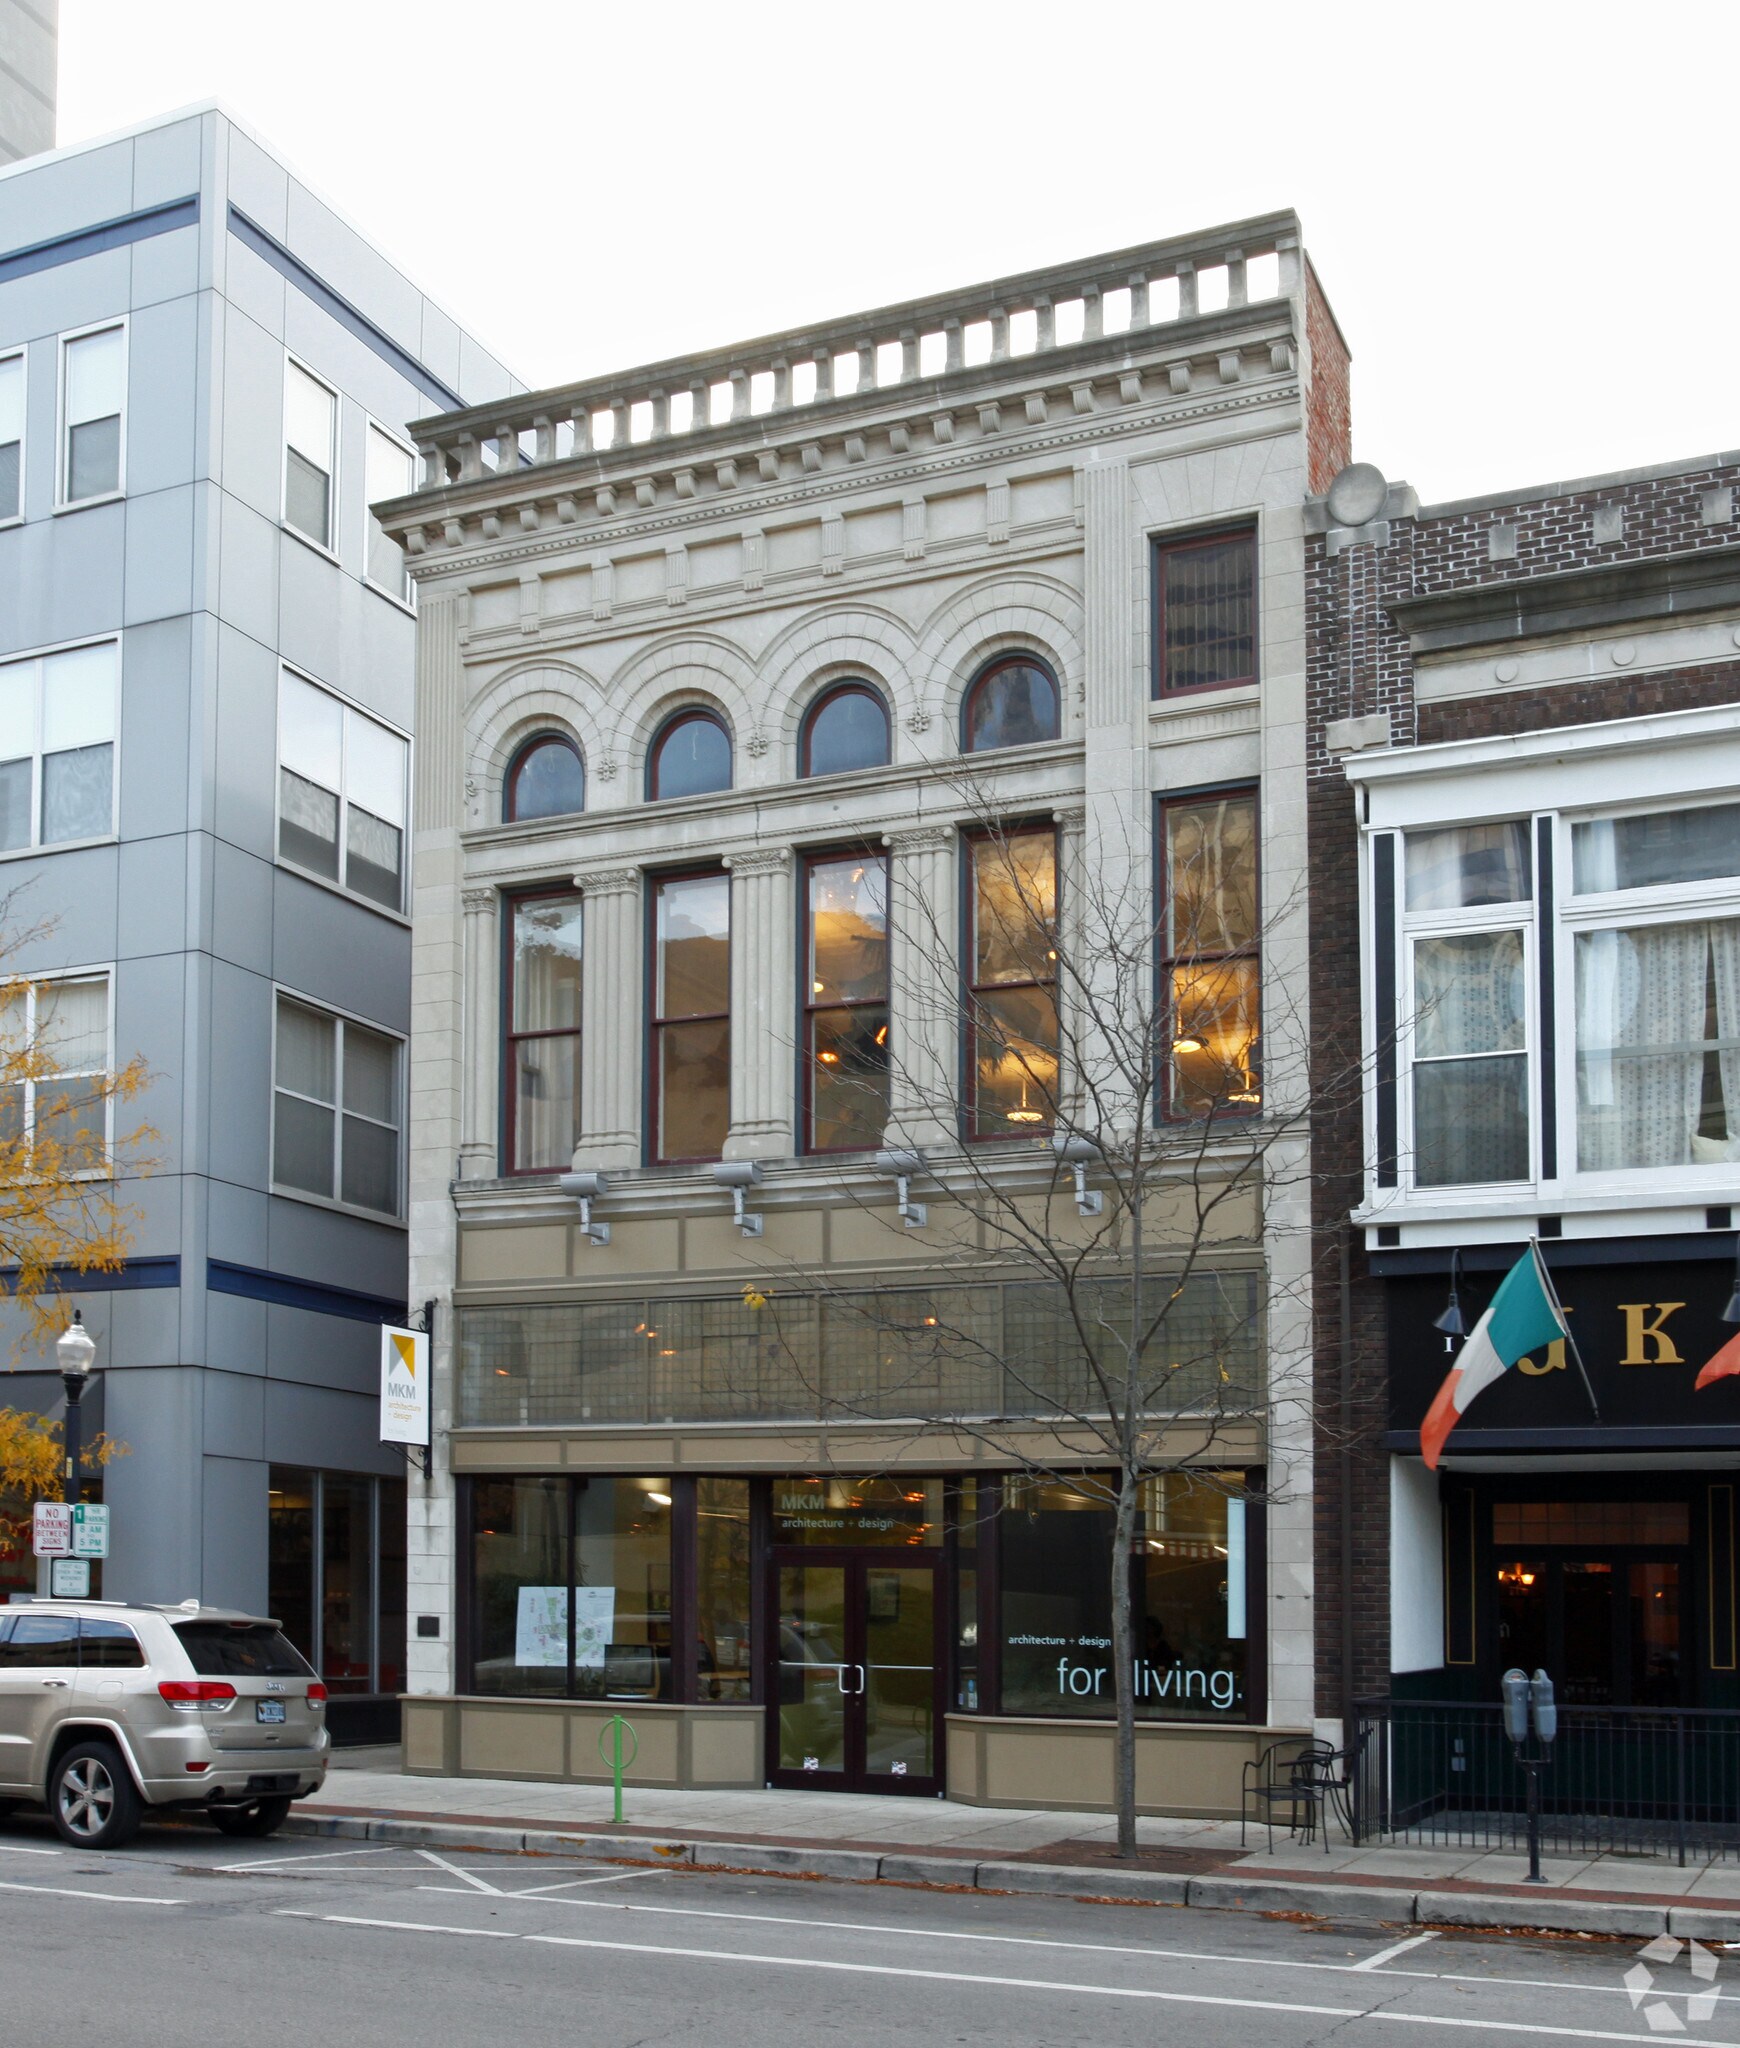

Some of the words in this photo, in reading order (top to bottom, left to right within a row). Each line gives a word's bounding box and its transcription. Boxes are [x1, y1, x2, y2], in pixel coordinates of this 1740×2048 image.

[388, 1382, 416, 1399] MKM
[388, 1401, 422, 1412] architecture
[393, 1411, 412, 1422] design
[782, 1494, 825, 1510] MKM
[46, 1508, 59, 1519] NO
[76, 1509, 82, 1520] 1
[36, 1519, 68, 1530] PARKING
[90, 1525, 102, 1533] AM
[782, 1517, 844, 1528] architecture
[858, 1517, 894, 1531] design
[36, 1529, 68, 1537] BETWEEN
[89, 1538, 102, 1546] PM
[1008, 1634, 1066, 1646] architecture
[1078, 1635, 1112, 1648] design
[1056, 1657, 1107, 1695] for
[1133, 1659, 1243, 1709] living.
